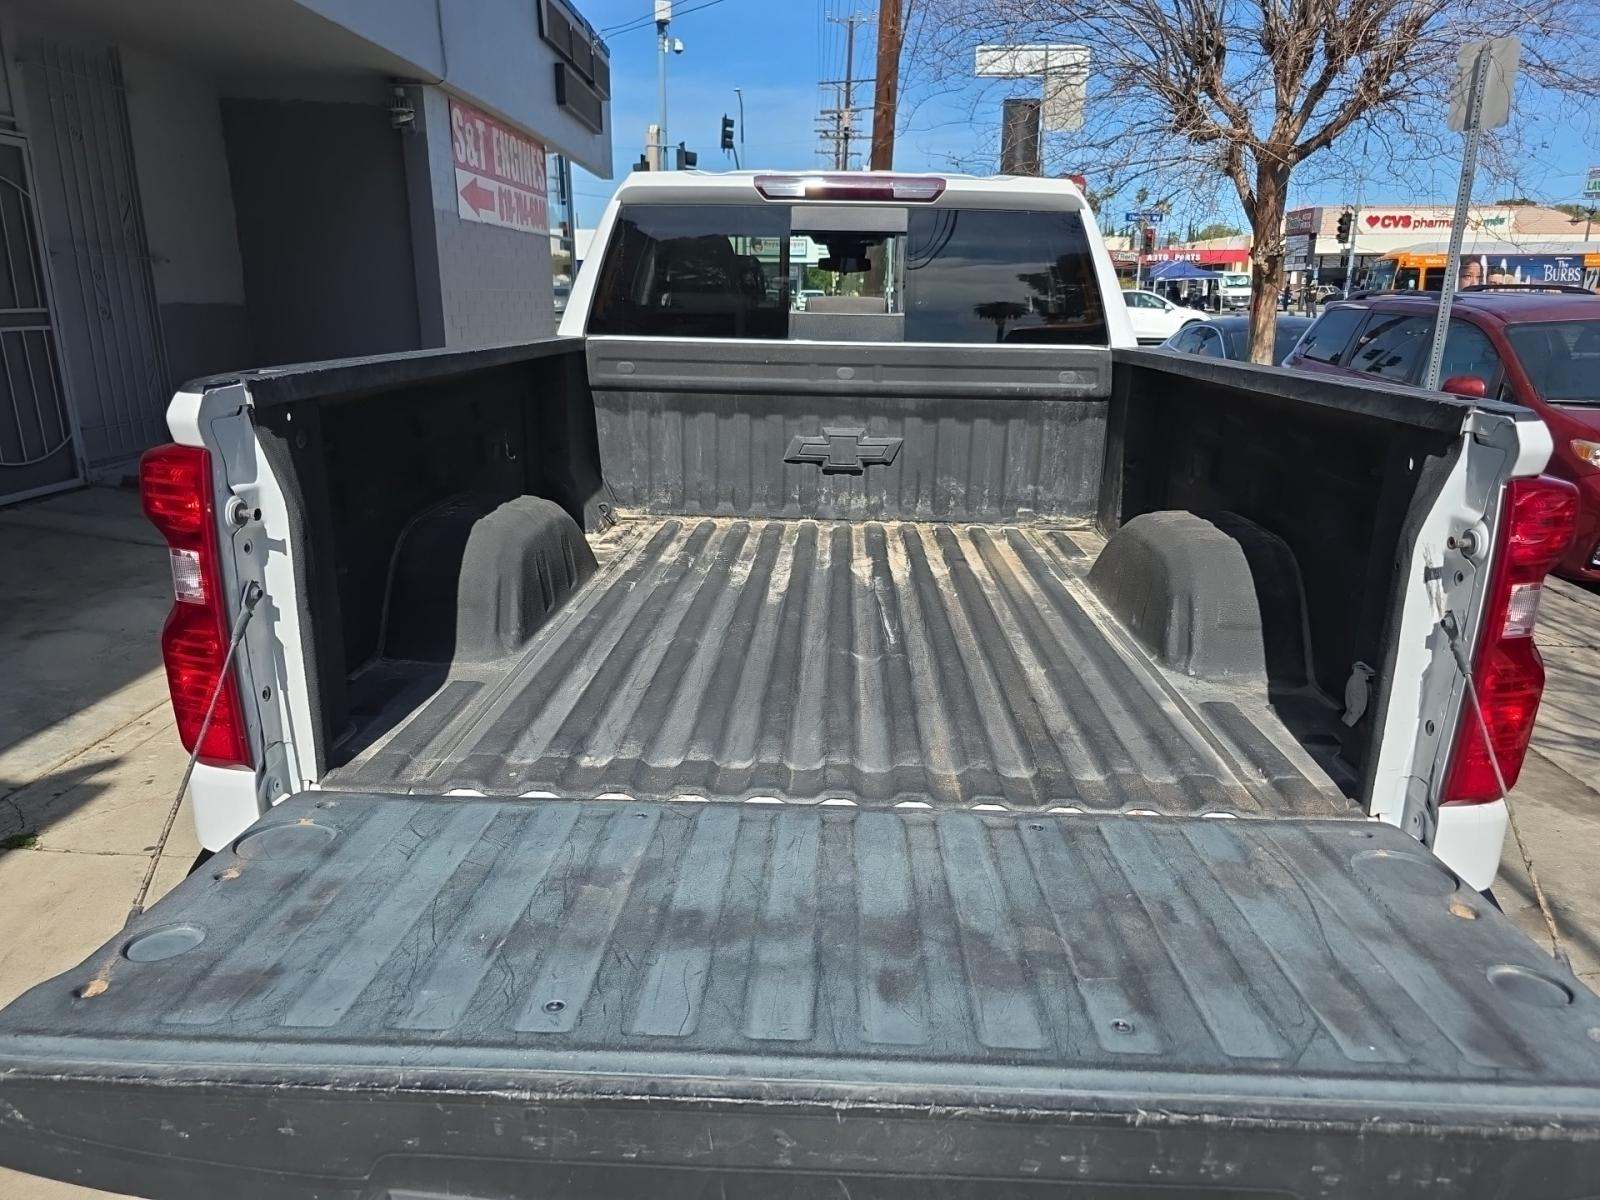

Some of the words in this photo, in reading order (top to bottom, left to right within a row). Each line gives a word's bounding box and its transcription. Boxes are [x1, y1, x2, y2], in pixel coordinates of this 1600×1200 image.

[452, 107, 486, 171] S&T
[492, 126, 546, 192] ENGINES
[1381, 214, 1412, 229] CVS
[1146, 253, 1169, 261] AUTO
[1174, 253, 1201, 261] PARTS
[1558, 260, 1569, 269] The
